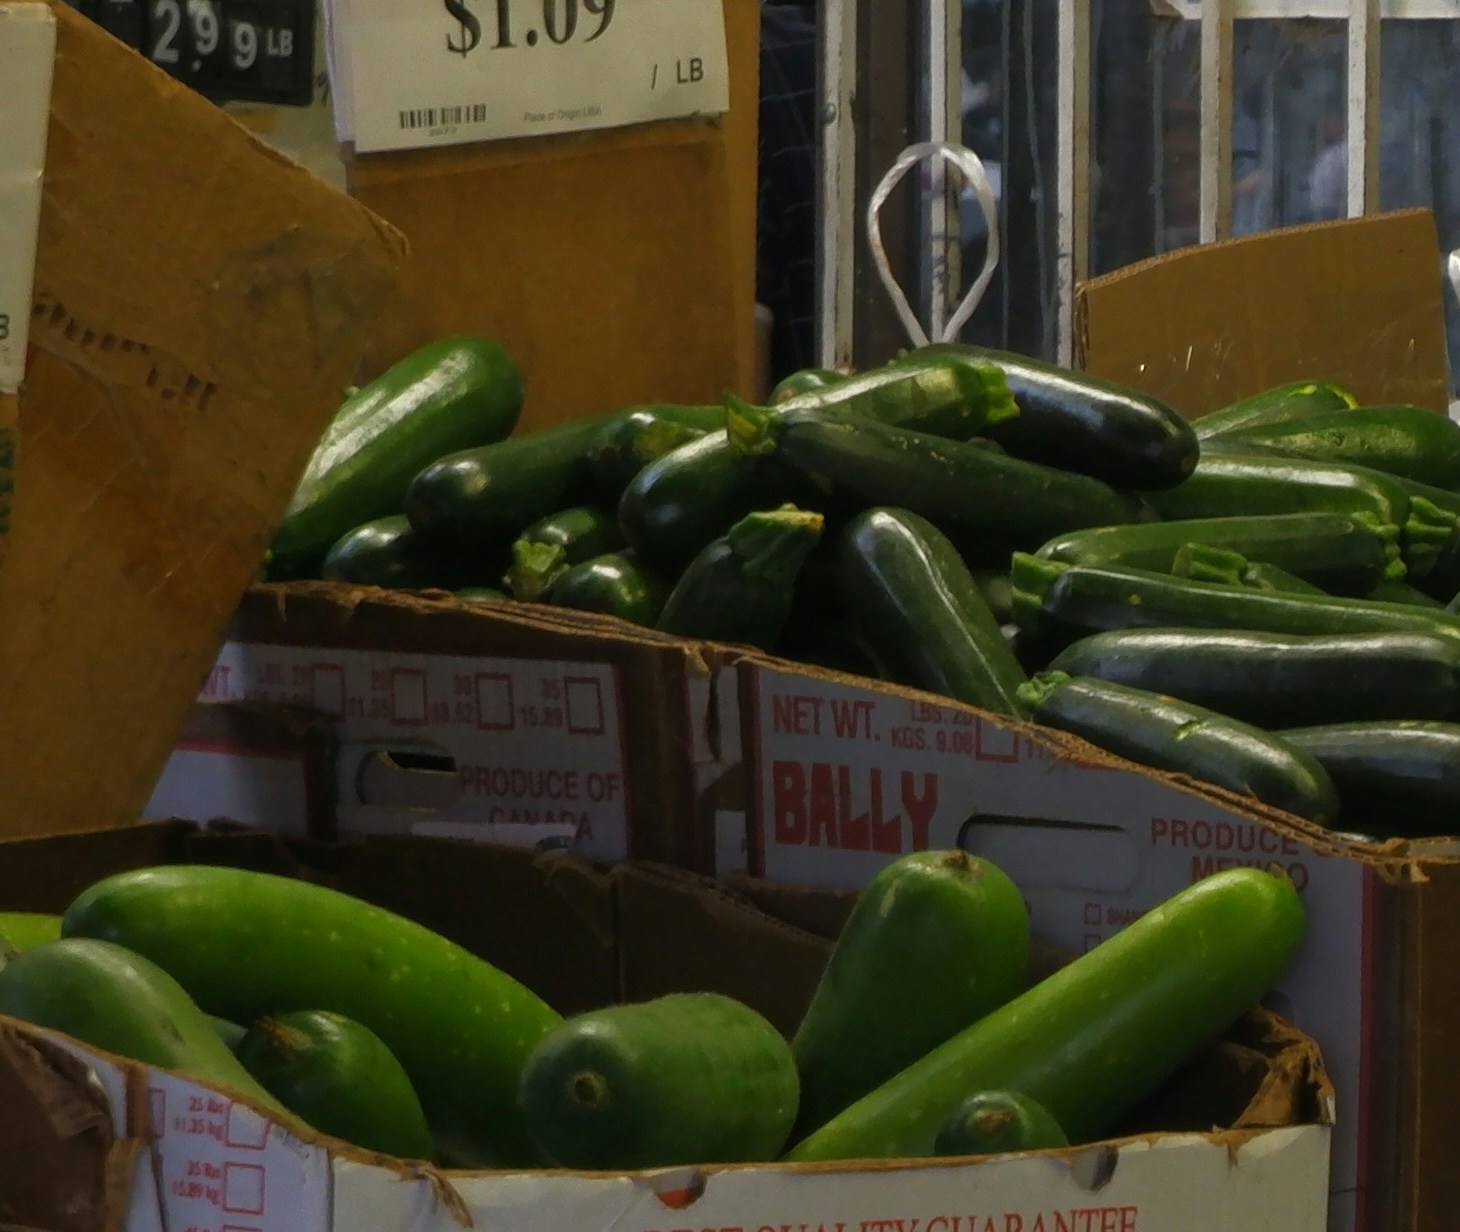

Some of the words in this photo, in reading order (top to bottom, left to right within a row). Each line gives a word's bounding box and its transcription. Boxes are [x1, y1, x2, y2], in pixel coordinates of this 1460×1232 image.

[266, 28, 293, 58] LB
[446, 0, 616, 59] $1.09
[676, 57, 704, 85] LB
[771, 693, 825, 738] NET
[831, 700, 881, 742] WT.
[458, 764, 579, 801] PRODUCE
[586, 770, 622, 802] OF
[772, 759, 939, 854] BALLY
[1151, 816, 1300, 857] PRODUCE
